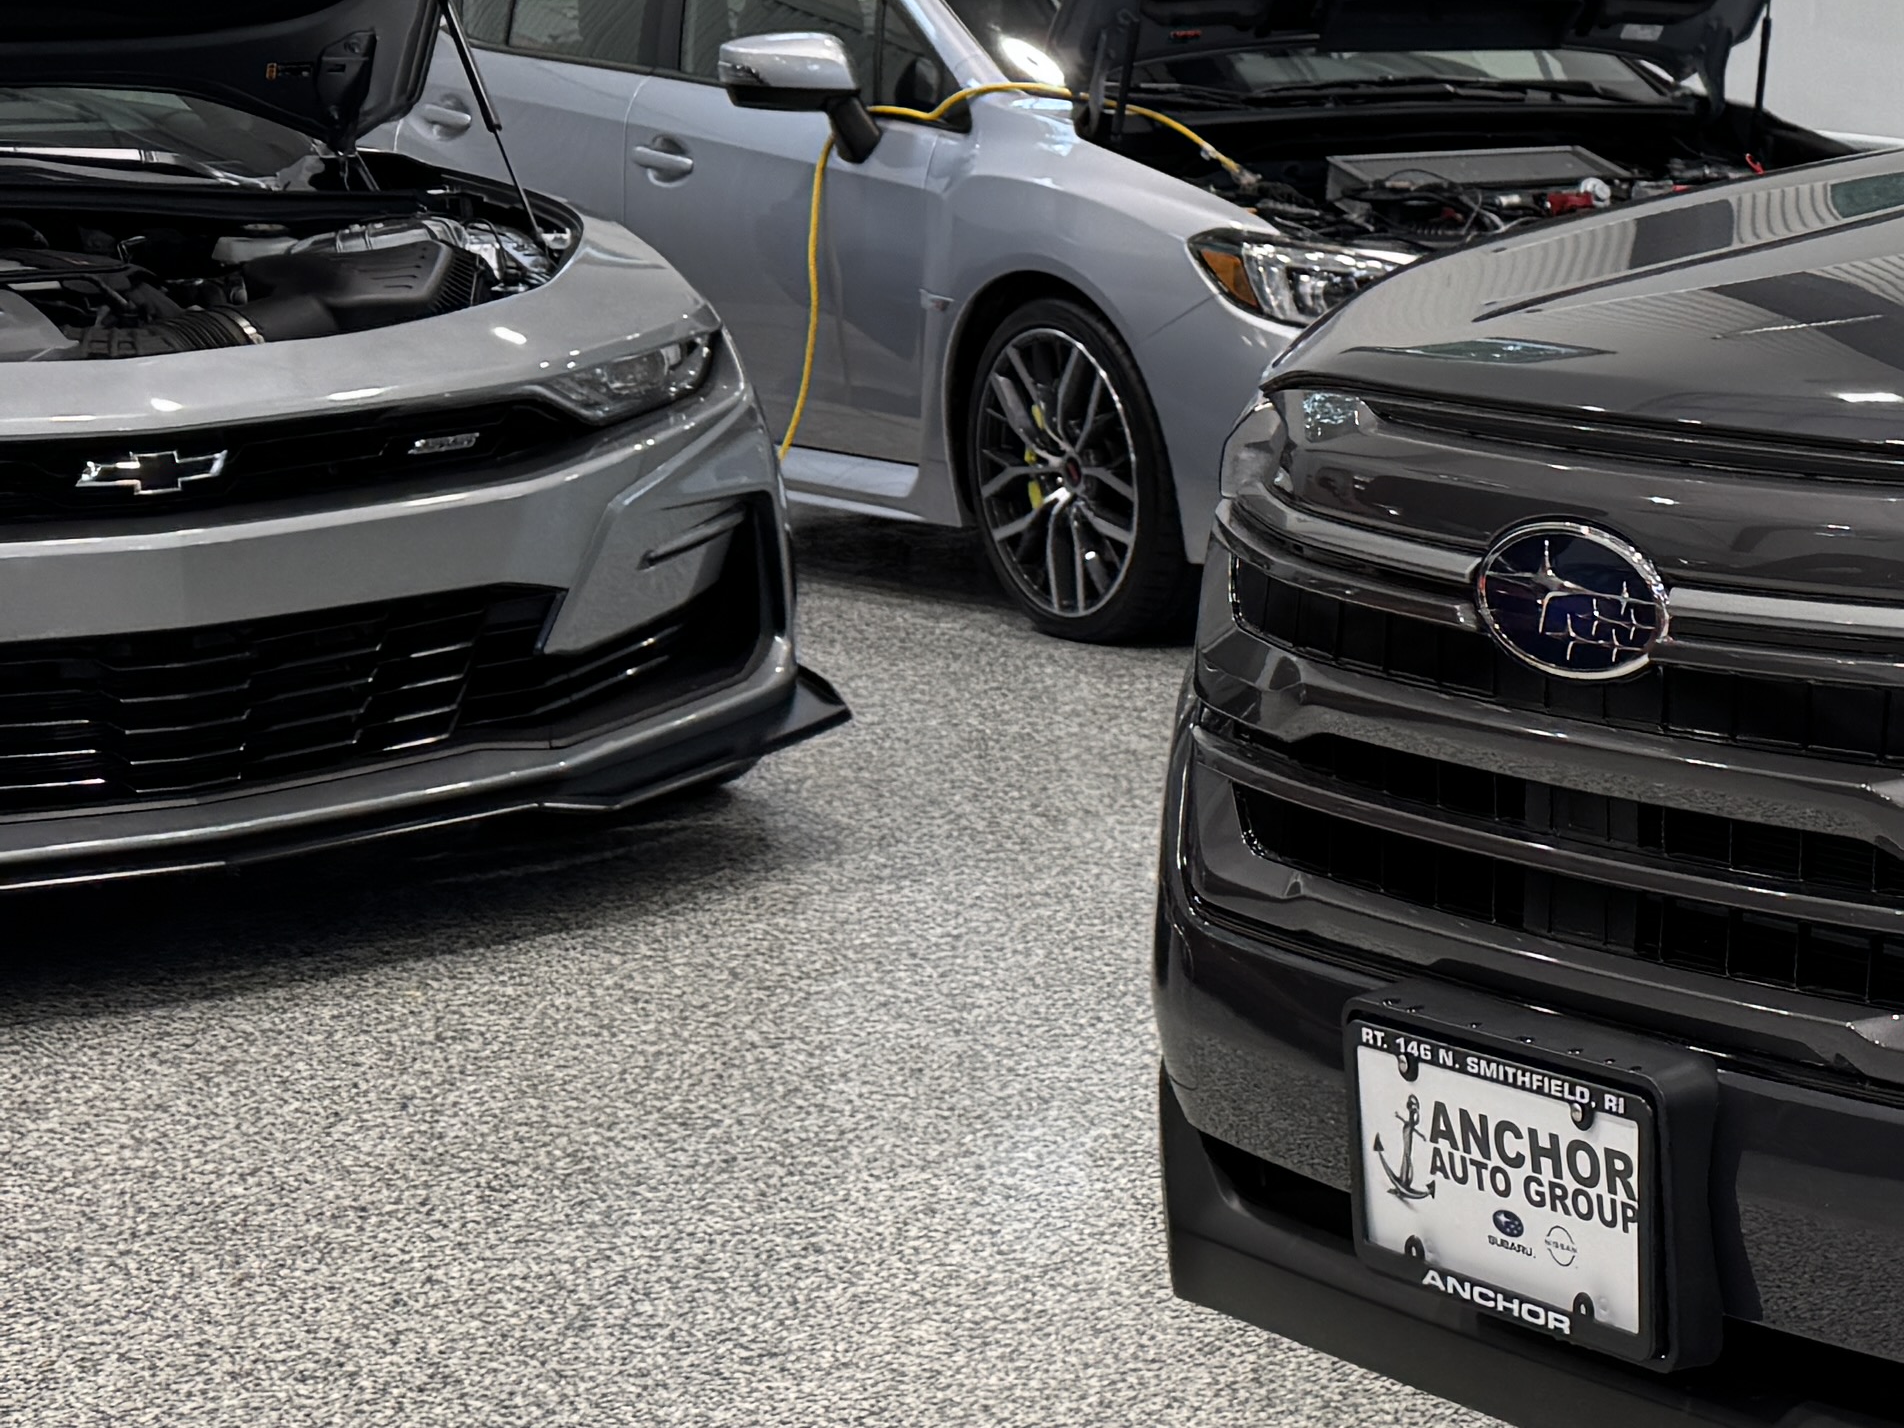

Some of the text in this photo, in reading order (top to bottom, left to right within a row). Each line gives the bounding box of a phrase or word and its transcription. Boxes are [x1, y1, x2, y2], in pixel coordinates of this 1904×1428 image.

[1361, 1026, 1625, 1114] RT. 146 N. SMITHFIELD, RI
[1429, 1100, 1638, 1202] ANCHOR
[1430, 1149, 1638, 1234] AUTO GROUP
[1422, 1268, 1571, 1336] ANCHOR
